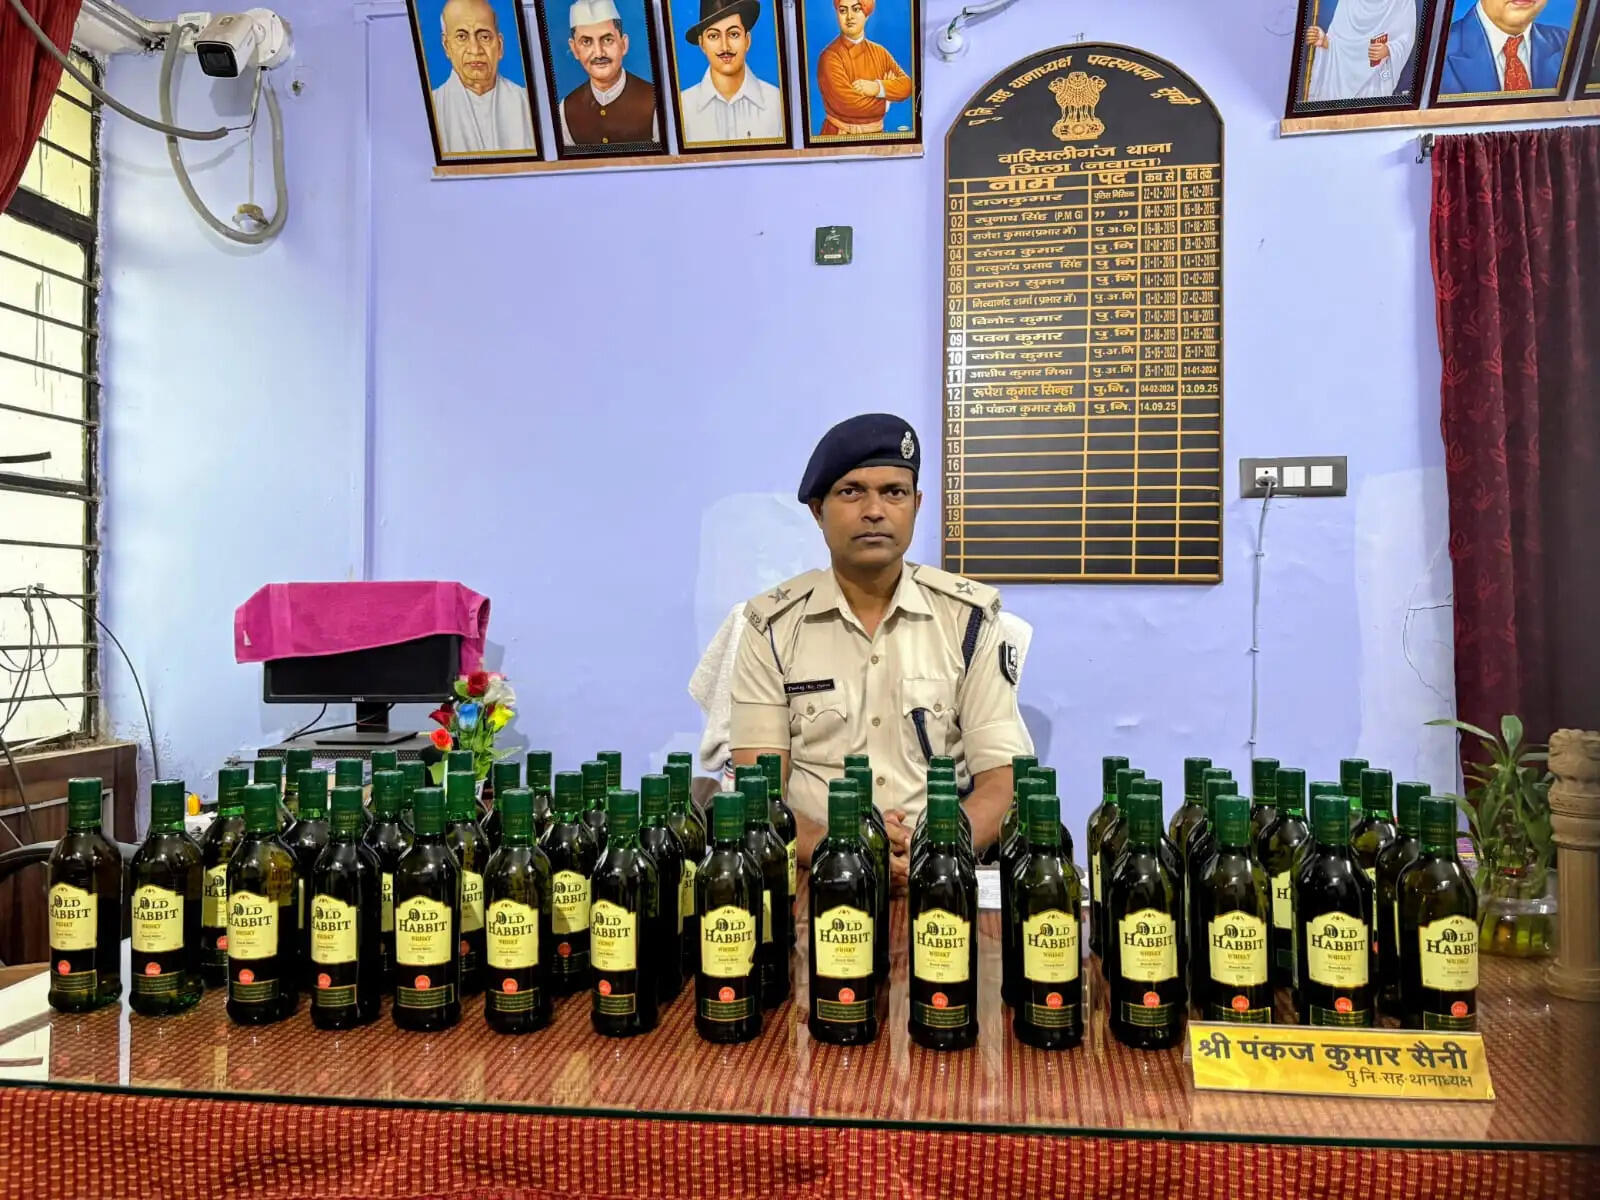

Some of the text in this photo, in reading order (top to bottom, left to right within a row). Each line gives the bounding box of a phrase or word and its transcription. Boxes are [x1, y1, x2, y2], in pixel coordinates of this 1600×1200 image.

[985, 88, 1015, 103] सह
[1008, 55, 1073, 89] थानाध्यक्ष
[1087, 54, 1165, 81] पदस्थापन
[1150, 86, 1202, 105] सूची
[1126, 142, 1173, 155] थाना
[1009, 157, 1161, 175] जिला (नवादा)
[988, 176, 1057, 191] नाम
[1098, 172, 1128, 184] पद
[1144, 172, 1163, 182] कब
[1166, 168, 1175, 182] से
[950, 199, 963, 210] 01
[972, 194, 1064, 207] राजकुमार
[950, 216, 963, 228] 02
[975, 215, 1018, 225] रघुनाथ
[1021, 212, 1048, 221] सिंह
[950, 233, 963, 244] 03
[950, 249, 962, 260] 04
[1020, 246, 1066, 257] कुमार
[950, 264, 962, 276] 05
[1023, 262, 1053, 271] प्रसाद
[1059, 259, 1082, 269] सिंह
[950, 282, 962, 294] 06
[974, 280, 1020, 289] मनोज
[1025, 278, 1065, 289] सुमन
[949, 300, 961, 311] 07
[1013, 295, 1032, 306] शर्मा
[950, 316, 962, 327] 08
[972, 316, 1015, 326] विनोद
[1020, 314, 1063, 325] कुमार
[950, 334, 963, 346] 09
[971, 334, 1010, 343] पवन
[1015, 332, 1064, 345] कुमार
[949, 352, 962, 364] 10
[971, 351, 1016, 360] राजीव
[1020, 351, 1064, 362] कुमार
[948, 370, 961, 382] 11
[1010, 369, 1041, 380] कुमार
[1045, 366, 1073, 377] मिश्रा
[948, 389, 961, 400] 12
[972, 385, 1002, 397] रूपेश
[1005, 386, 1038, 400] कुमार
[1041, 384, 1074, 396] सिन्हा
[1181, 384, 1218, 393] 13.09.25
[949, 406, 961, 417] 13
[970, 404, 983, 415] श्री
[986, 404, 1017, 414] पंकज
[1020, 404, 1051, 416] कुमार
[1140, 402, 1177, 411] 14.09.25
[947, 422, 960, 435] 14
[947, 441, 960, 454] 15
[947, 459, 960, 471] 16
[947, 477, 960, 489] 17
[947, 493, 960, 505] 18
[947, 509, 960, 521] 19
[947, 524, 960, 537] 20
[553, 882, 582, 894] OLD
[54, 894, 81, 909] OLD
[140, 897, 169, 910] OLD
[133, 907, 178, 921] HABBIT
[233, 903, 262, 916] OLD
[315, 907, 342, 920] OLD
[409, 908, 439, 922] OLD
[496, 911, 525, 924] OLD
[594, 911, 622, 926] OLD
[399, 919, 448, 933] HABBIT
[488, 921, 533, 935] HABBIT
[716, 918, 746, 932] OLD
[832, 918, 862, 932] OLD
[926, 922, 957, 935] OLD
[1040, 922, 1070, 936] OLD
[1136, 922, 1167, 935] OLD
[1223, 924, 1257, 938] OLD
[1323, 924, 1357, 938] OLD
[705, 928, 753, 943] HABBIT
[819, 929, 870, 944] HABBIT
[917, 932, 965, 948] HABBIT
[1028, 933, 1077, 948] HABBIT
[1124, 932, 1173, 948] HABBIT
[1442, 928, 1474, 942] OLD
[1213, 935, 1264, 950] HABBIT
[1311, 935, 1365, 951] HABBIT
[1198, 1032, 1467, 1071] श्री पंकज कुमार सैनी
